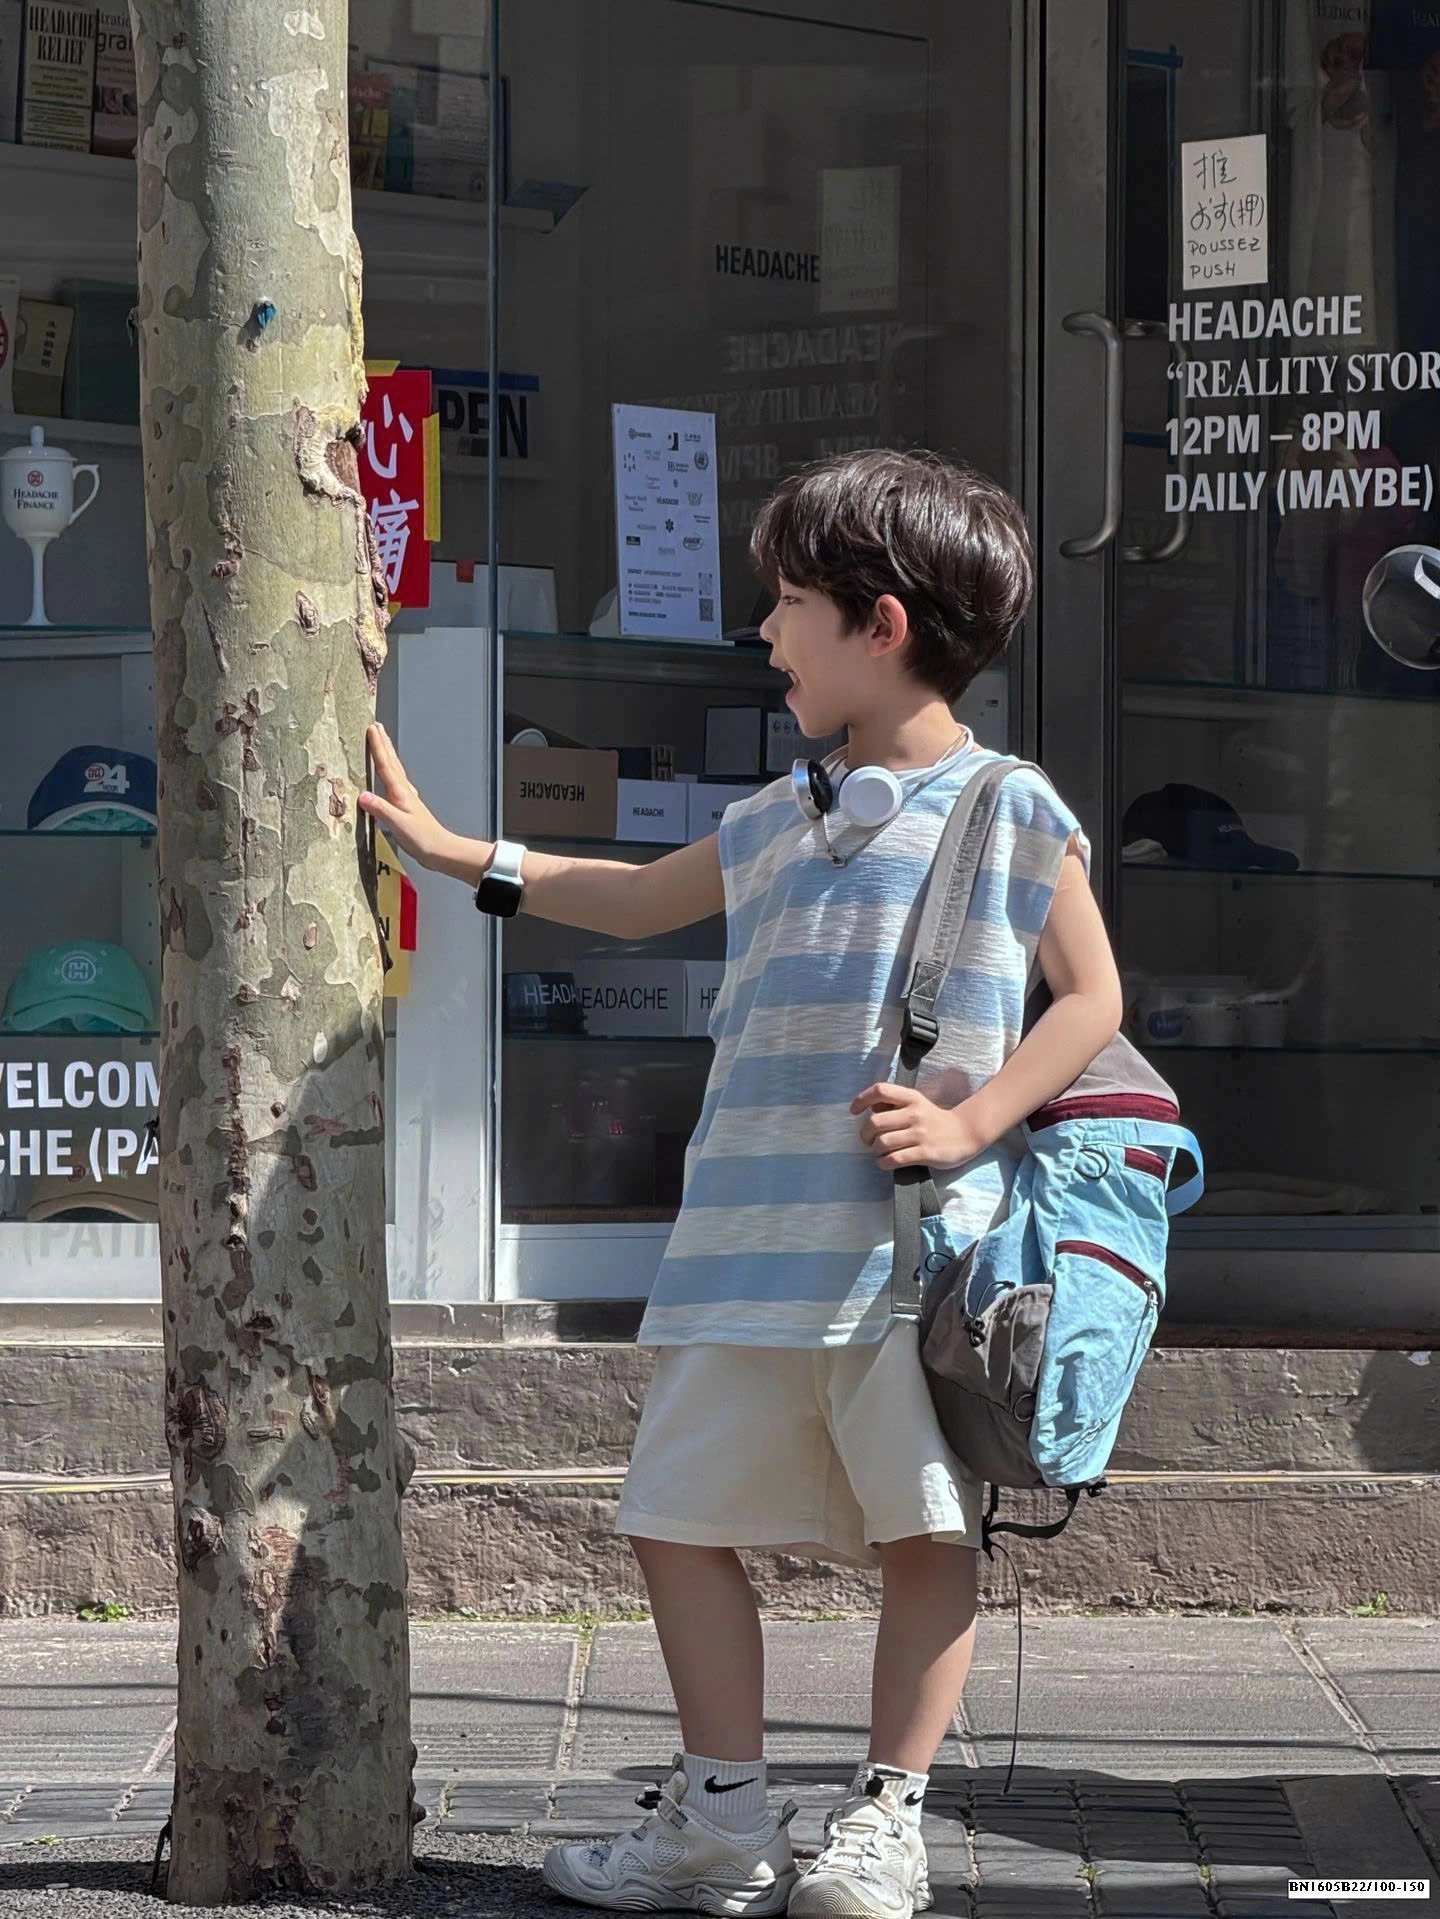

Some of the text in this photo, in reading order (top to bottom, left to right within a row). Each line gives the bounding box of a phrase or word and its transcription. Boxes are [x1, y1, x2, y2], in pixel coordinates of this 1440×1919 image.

[29, 6, 96, 39] HEADACHE
[37, 35, 86, 65] RELIEF
[1193, 149, 1237, 190] 推
[1190, 192, 1265, 232] おす(押)
[716, 244, 821, 283] HEADACHE
[1188, 238, 1261, 256] POUSSEZ
[1190, 261, 1236, 280] PUSH
[1168, 295, 1362, 342] HEADACHE
[1165, 415, 1261, 456] 12PM
[1302, 410, 1381, 452] 8PM
[1164, 464, 1434, 516] DAILY (MAYBE)
[519, 781, 585, 802] HEADACHE
[632, 807, 665, 818] HEADACHE
[578, 987, 669, 1009] EADACHE
[0, 1061, 159, 1110] ELCOM
[0, 1129, 74, 1176] HE
